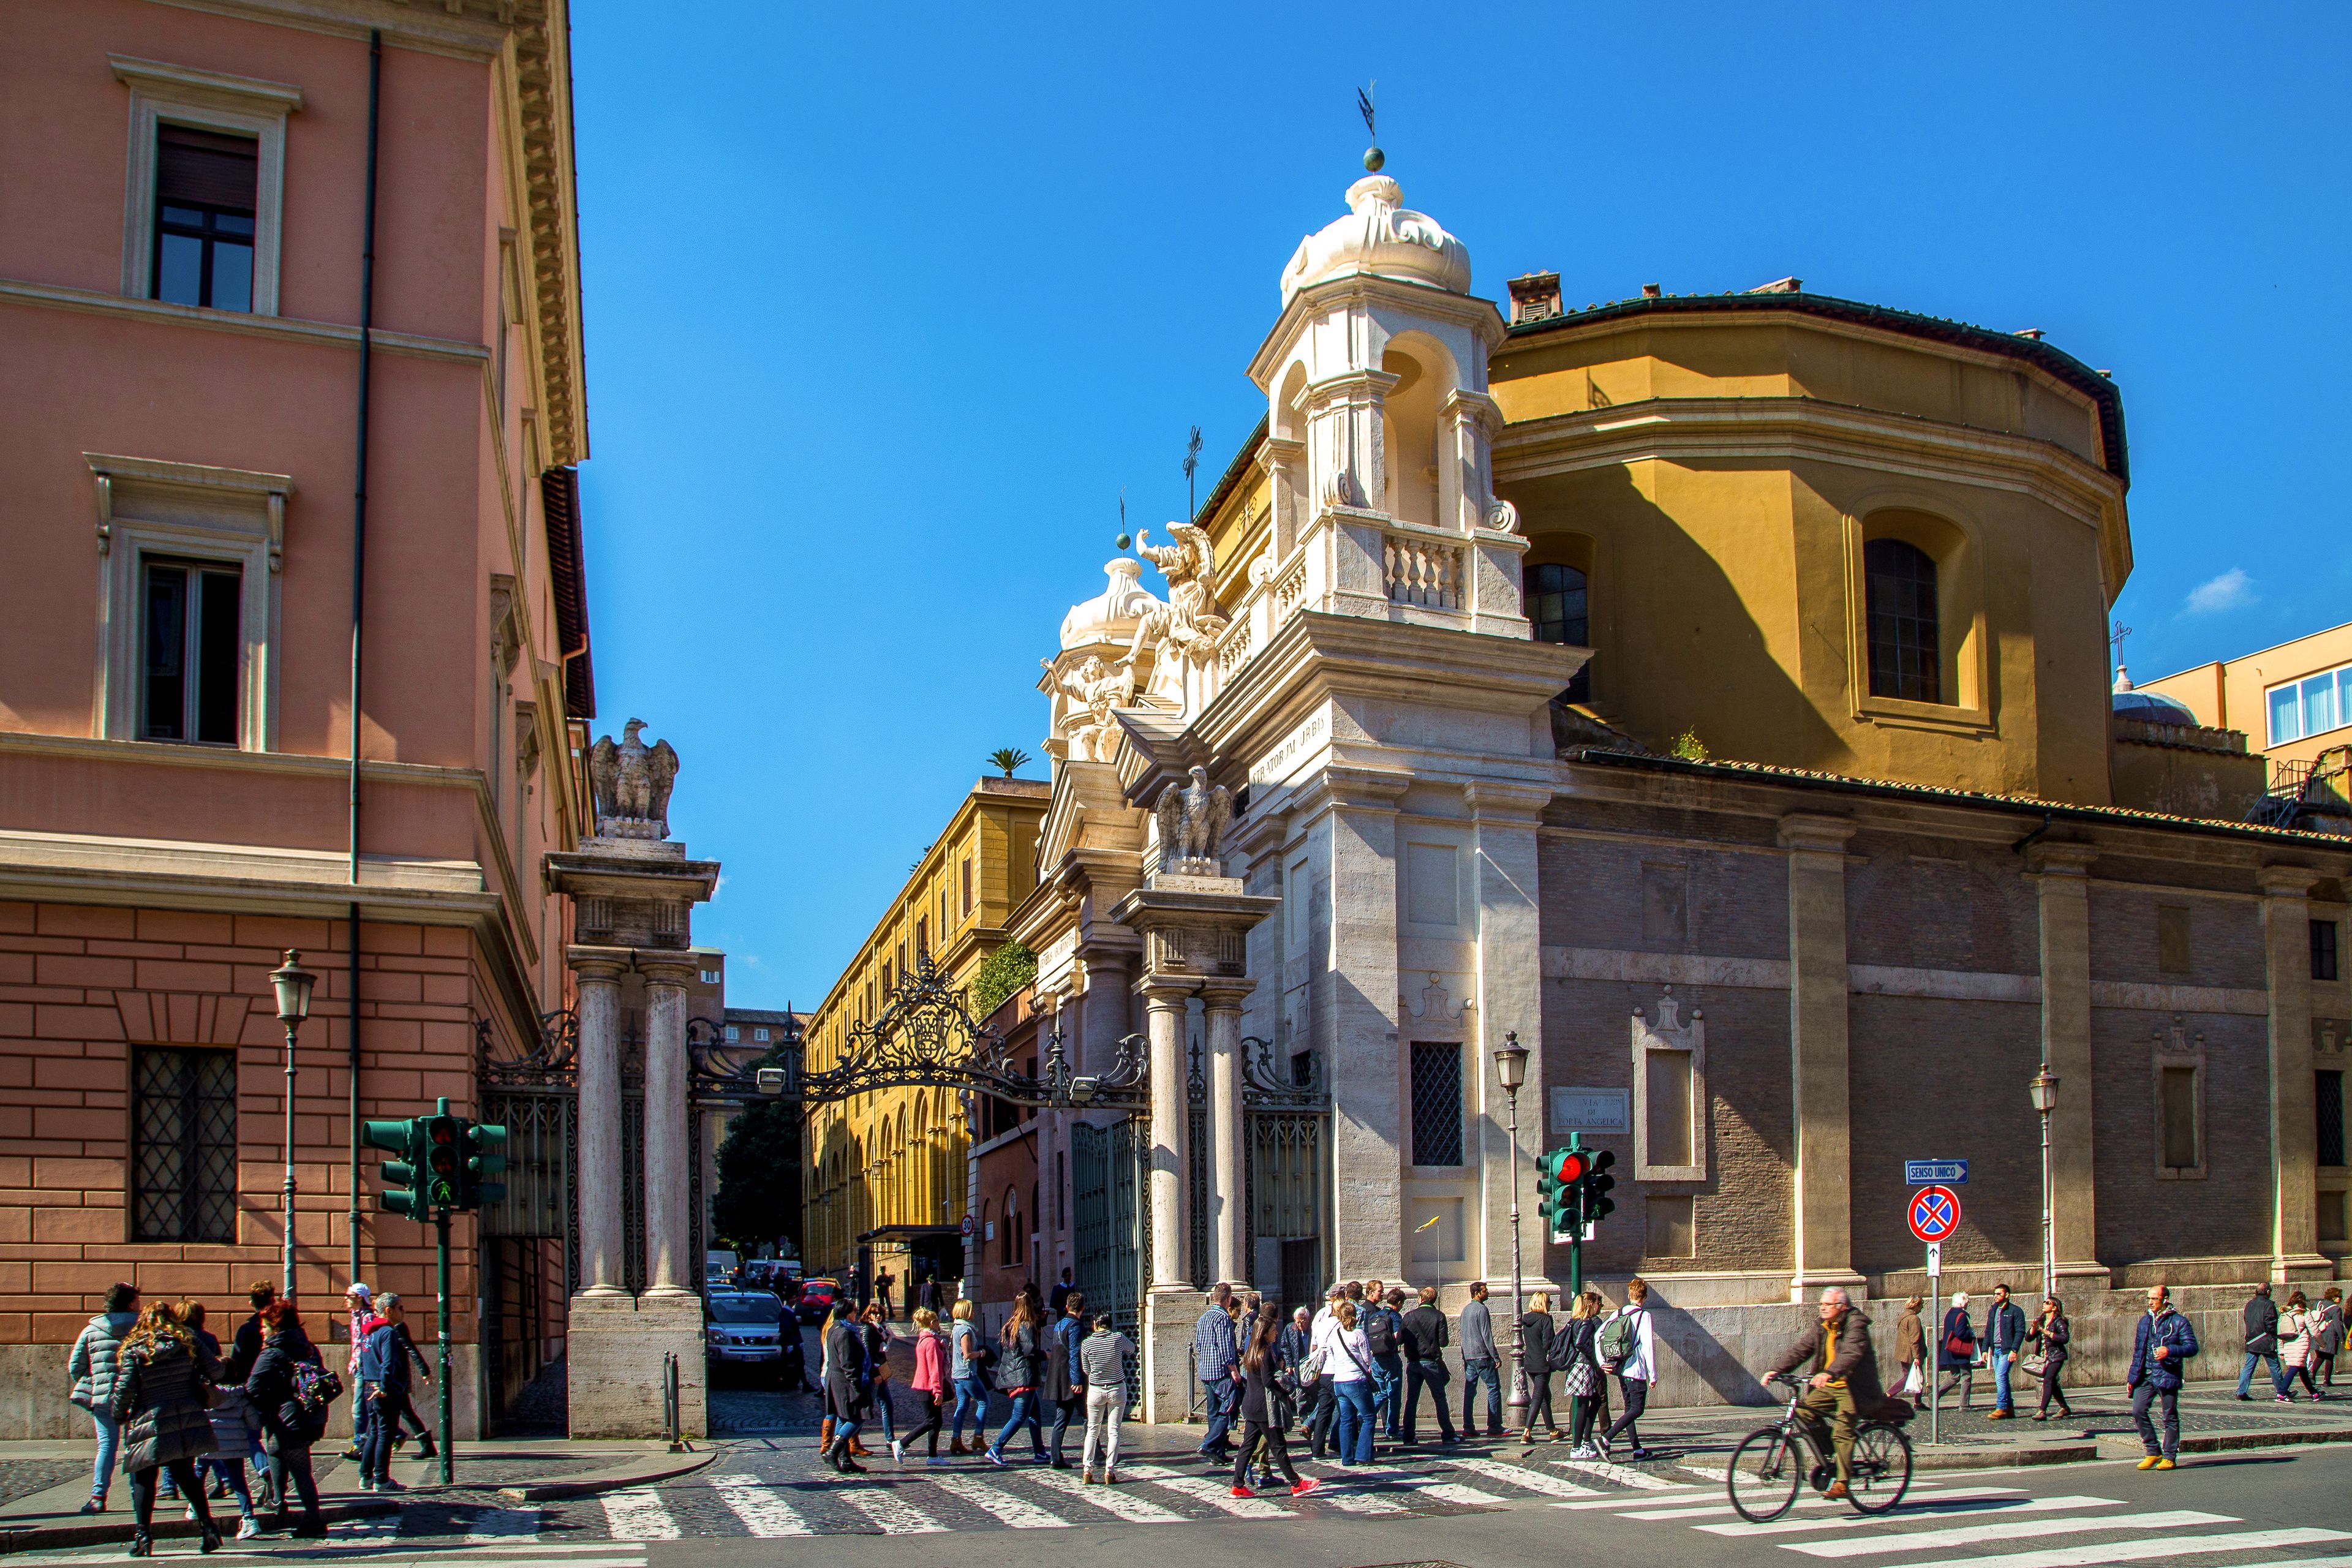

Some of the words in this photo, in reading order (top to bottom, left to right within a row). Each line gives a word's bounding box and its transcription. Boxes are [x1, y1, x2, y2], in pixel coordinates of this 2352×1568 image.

[1252, 739, 1296, 788] STRATORUM
[1300, 714, 1325, 747] URBIS
[1911, 1167, 1933, 1178] SENSO
[1934, 1166, 1956, 1177] UNICO
[963, 1220, 971, 1231] 30
